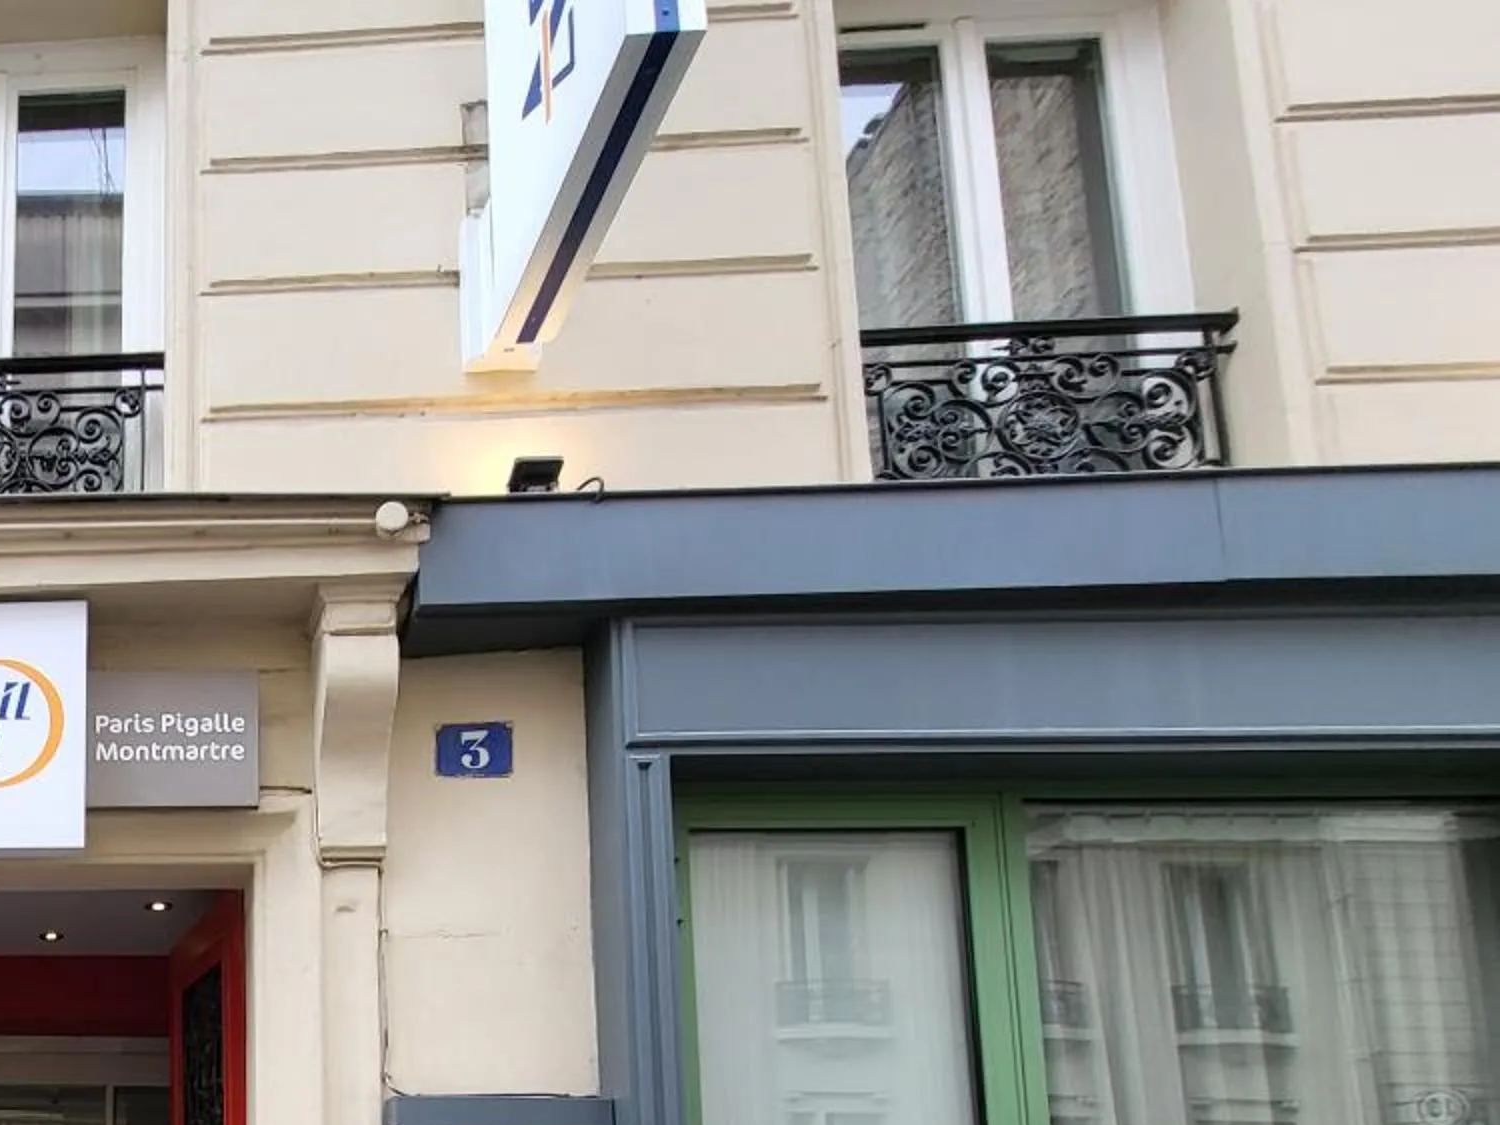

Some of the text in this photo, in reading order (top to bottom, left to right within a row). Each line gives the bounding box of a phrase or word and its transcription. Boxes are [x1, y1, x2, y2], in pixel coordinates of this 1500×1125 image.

[95, 712, 245, 737] Paris Pigalle
[95, 741, 245, 761] Montmartre
[461, 729, 490, 769] 3
